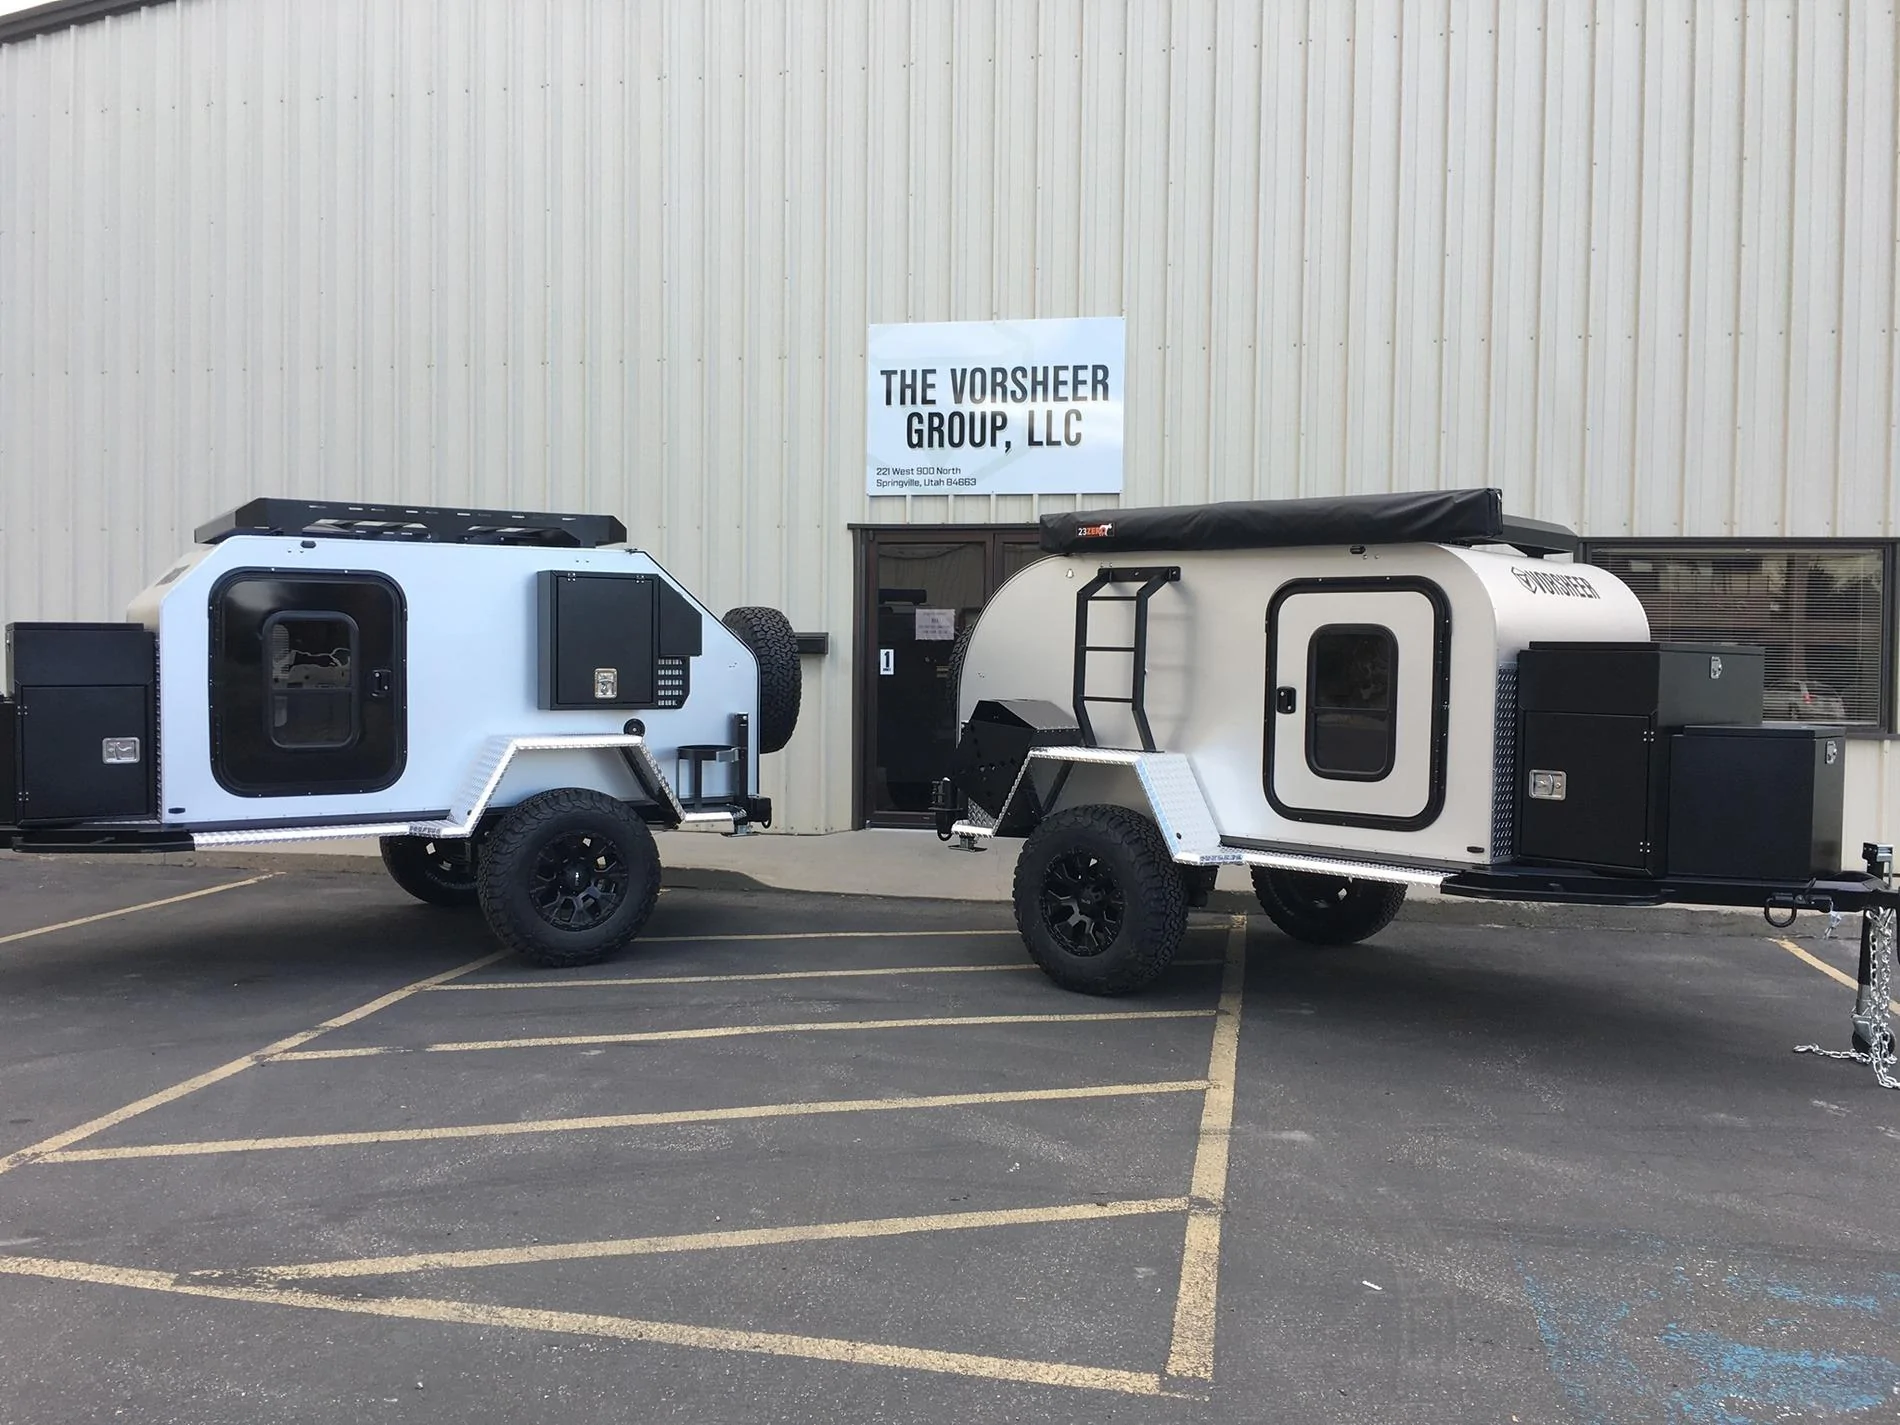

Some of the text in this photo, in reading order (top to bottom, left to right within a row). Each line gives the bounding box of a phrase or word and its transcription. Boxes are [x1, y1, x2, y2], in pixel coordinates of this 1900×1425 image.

[880, 364, 1110, 406] THE VORSHEER
[906, 408, 1083, 453] GROUP, LLC
[876, 466, 961, 476] 221 West 900 North
[876, 477, 977, 488] Springville, Utah 84663
[1525, 569, 1601, 599] VORSHEER
[884, 651, 890, 668] 1
